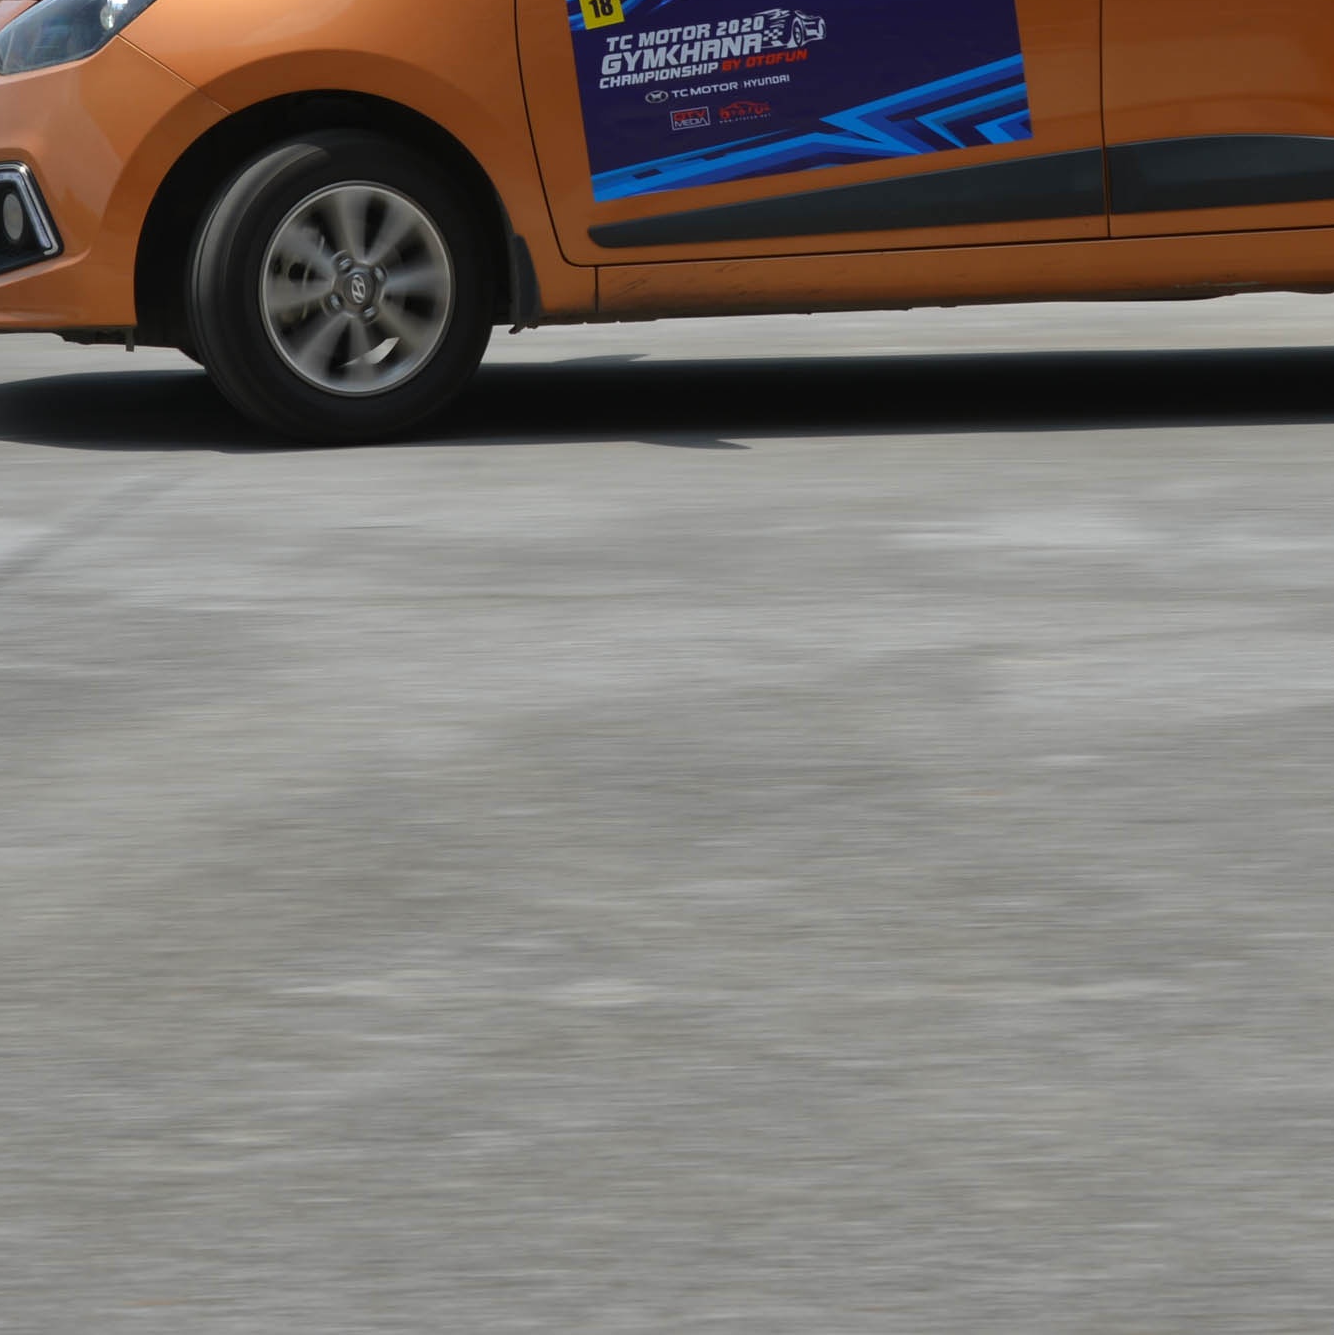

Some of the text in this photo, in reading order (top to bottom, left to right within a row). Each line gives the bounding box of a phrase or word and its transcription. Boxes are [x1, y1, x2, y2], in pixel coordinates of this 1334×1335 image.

[606, 15, 765, 52] TC MOTOR 2020
[599, 48, 809, 89] CHAMPIONSHIP BY OTOFUN
[601, 32, 764, 76] GYMKHANA
[671, 74, 790, 98] TC MOTOR HYUNDAI
